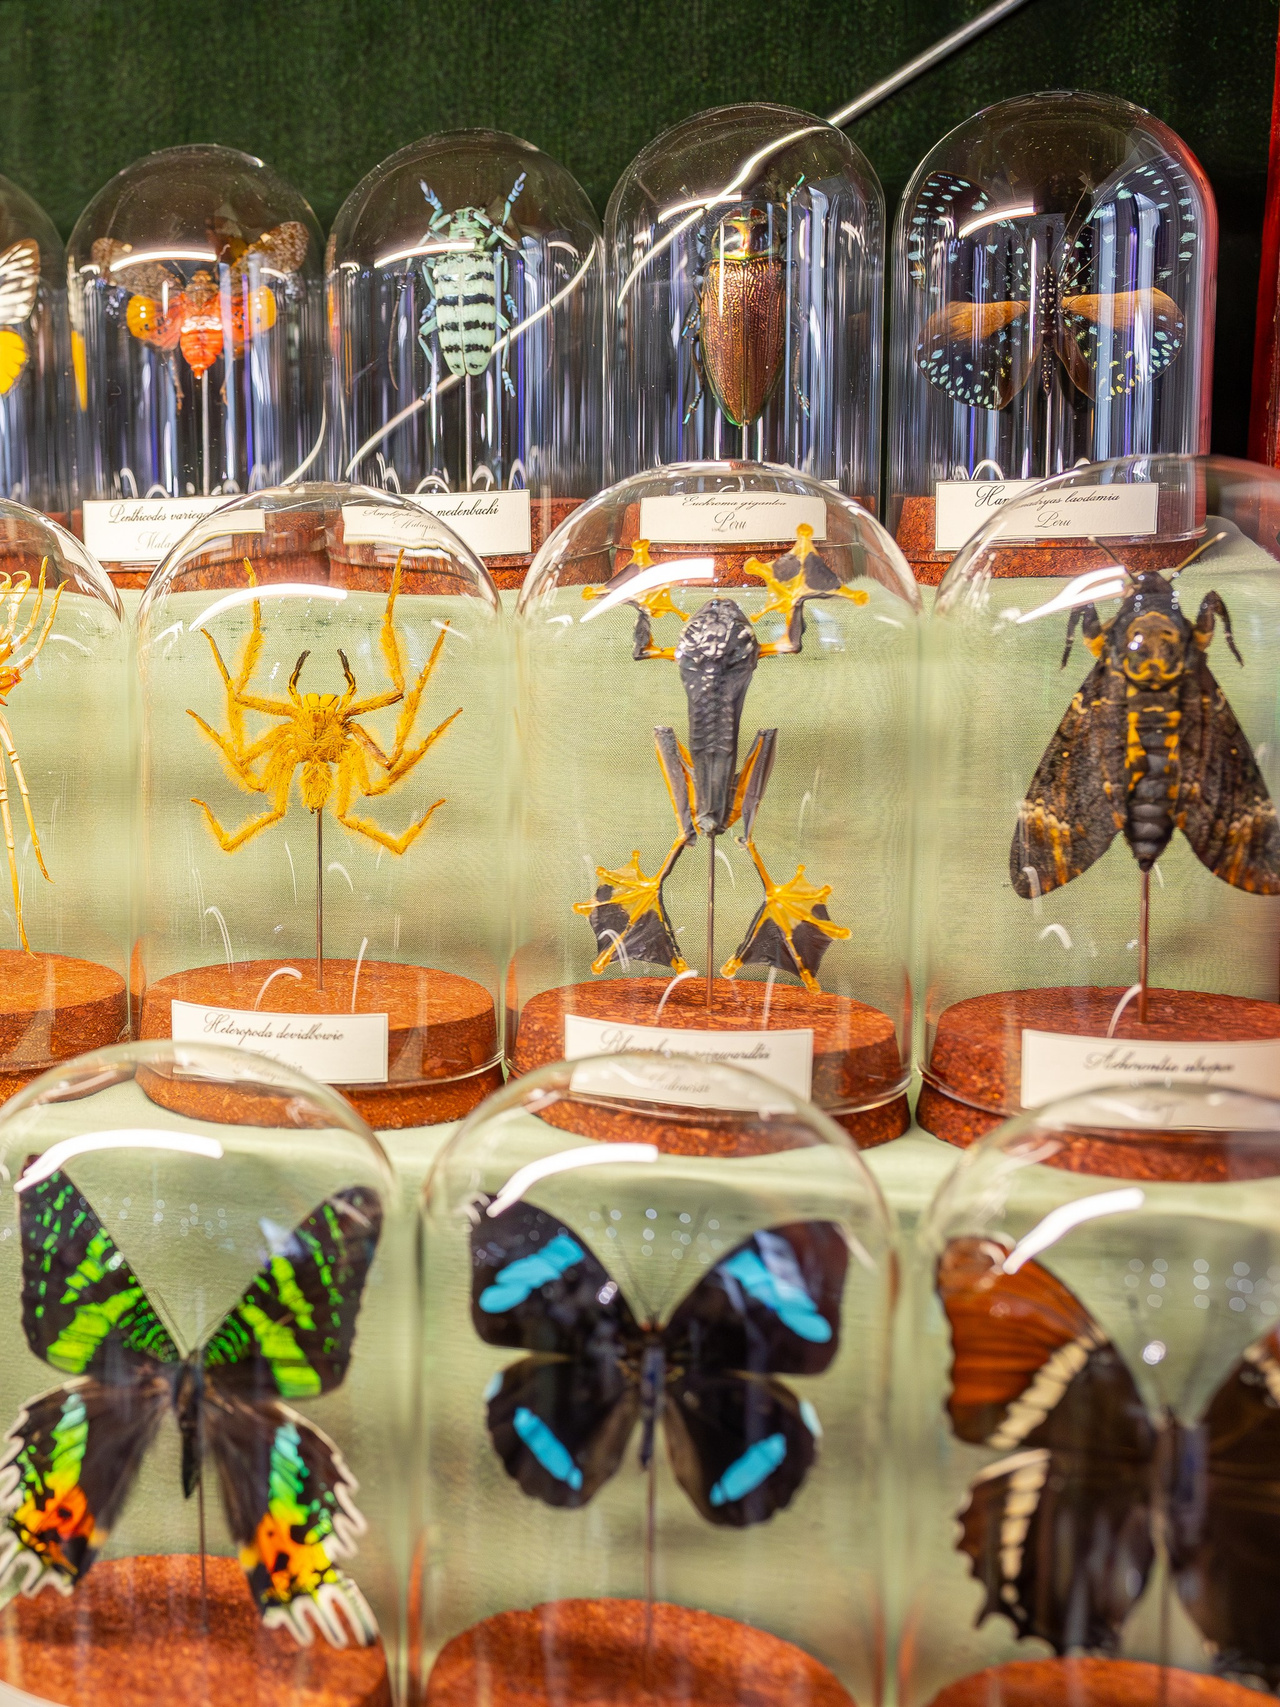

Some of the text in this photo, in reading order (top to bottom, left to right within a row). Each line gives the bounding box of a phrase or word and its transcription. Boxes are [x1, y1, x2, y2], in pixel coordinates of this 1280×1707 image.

[1064, 490, 1121, 504] laodamia
[108, 503, 167, 524] Penthicodes
[435, 498, 499, 518] medenbachi
[711, 510, 746, 532] Peru
[1034, 510, 1071, 528] Peru
[203, 1012, 273, 1046] Heteropoda
